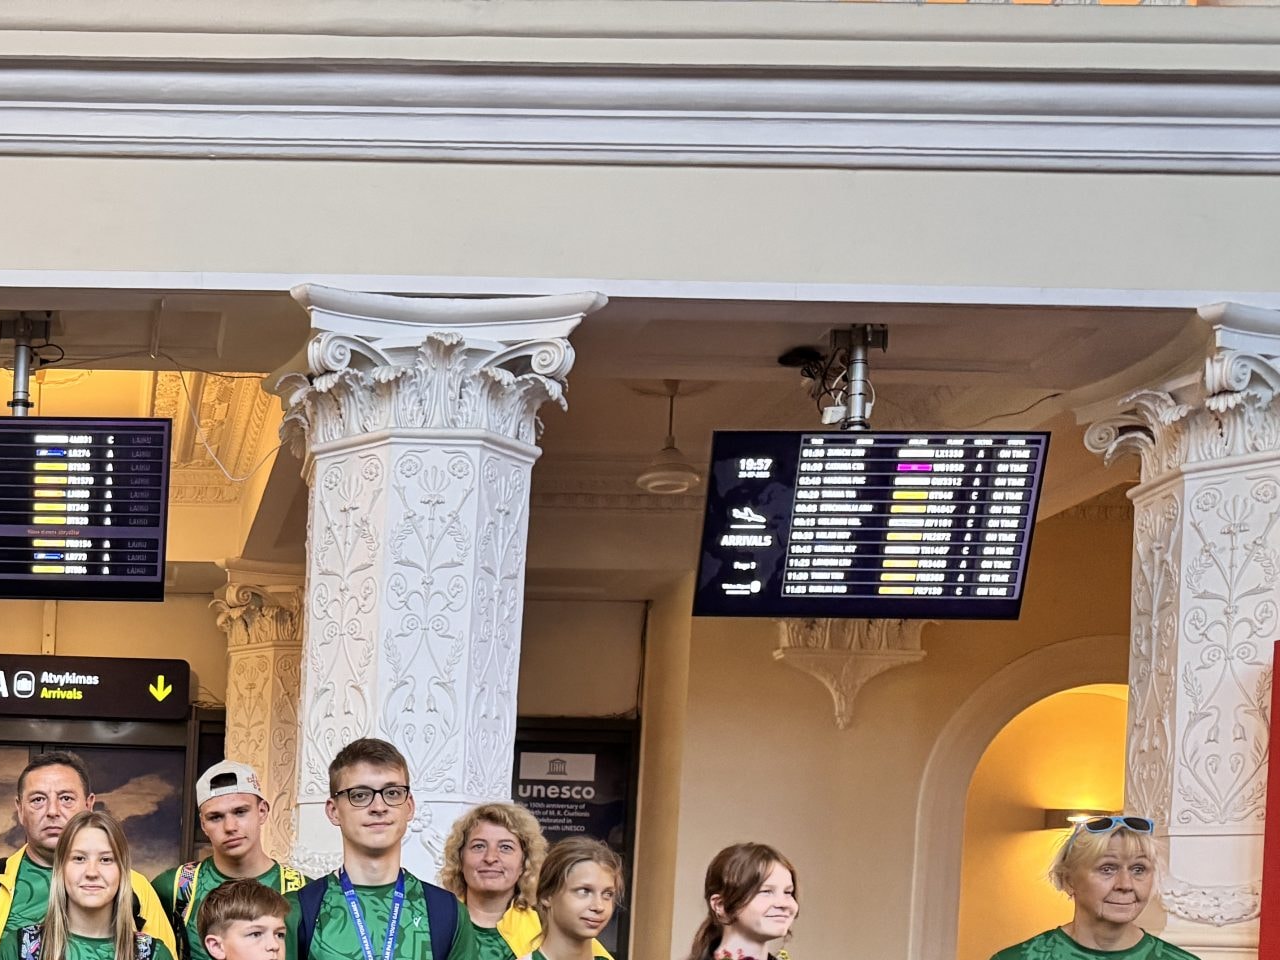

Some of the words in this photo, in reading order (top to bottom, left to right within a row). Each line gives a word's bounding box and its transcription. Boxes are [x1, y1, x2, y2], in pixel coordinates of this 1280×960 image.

[739, 458, 773, 471] 19:57
[720, 534, 773, 547] ARRIVALS
[40, 671, 100, 687] Atvykimas
[40, 687, 83, 700] Arrivals
[517, 784, 596, 800] unesco
[350, 901, 360, 920] GAMES
[392, 903, 400, 920] GAMES
[356, 918, 365, 936] YOUTH
[389, 919, 397, 937] YOUTH
[362, 935, 371, 951] PARA
[385, 937, 393, 951] PARA
